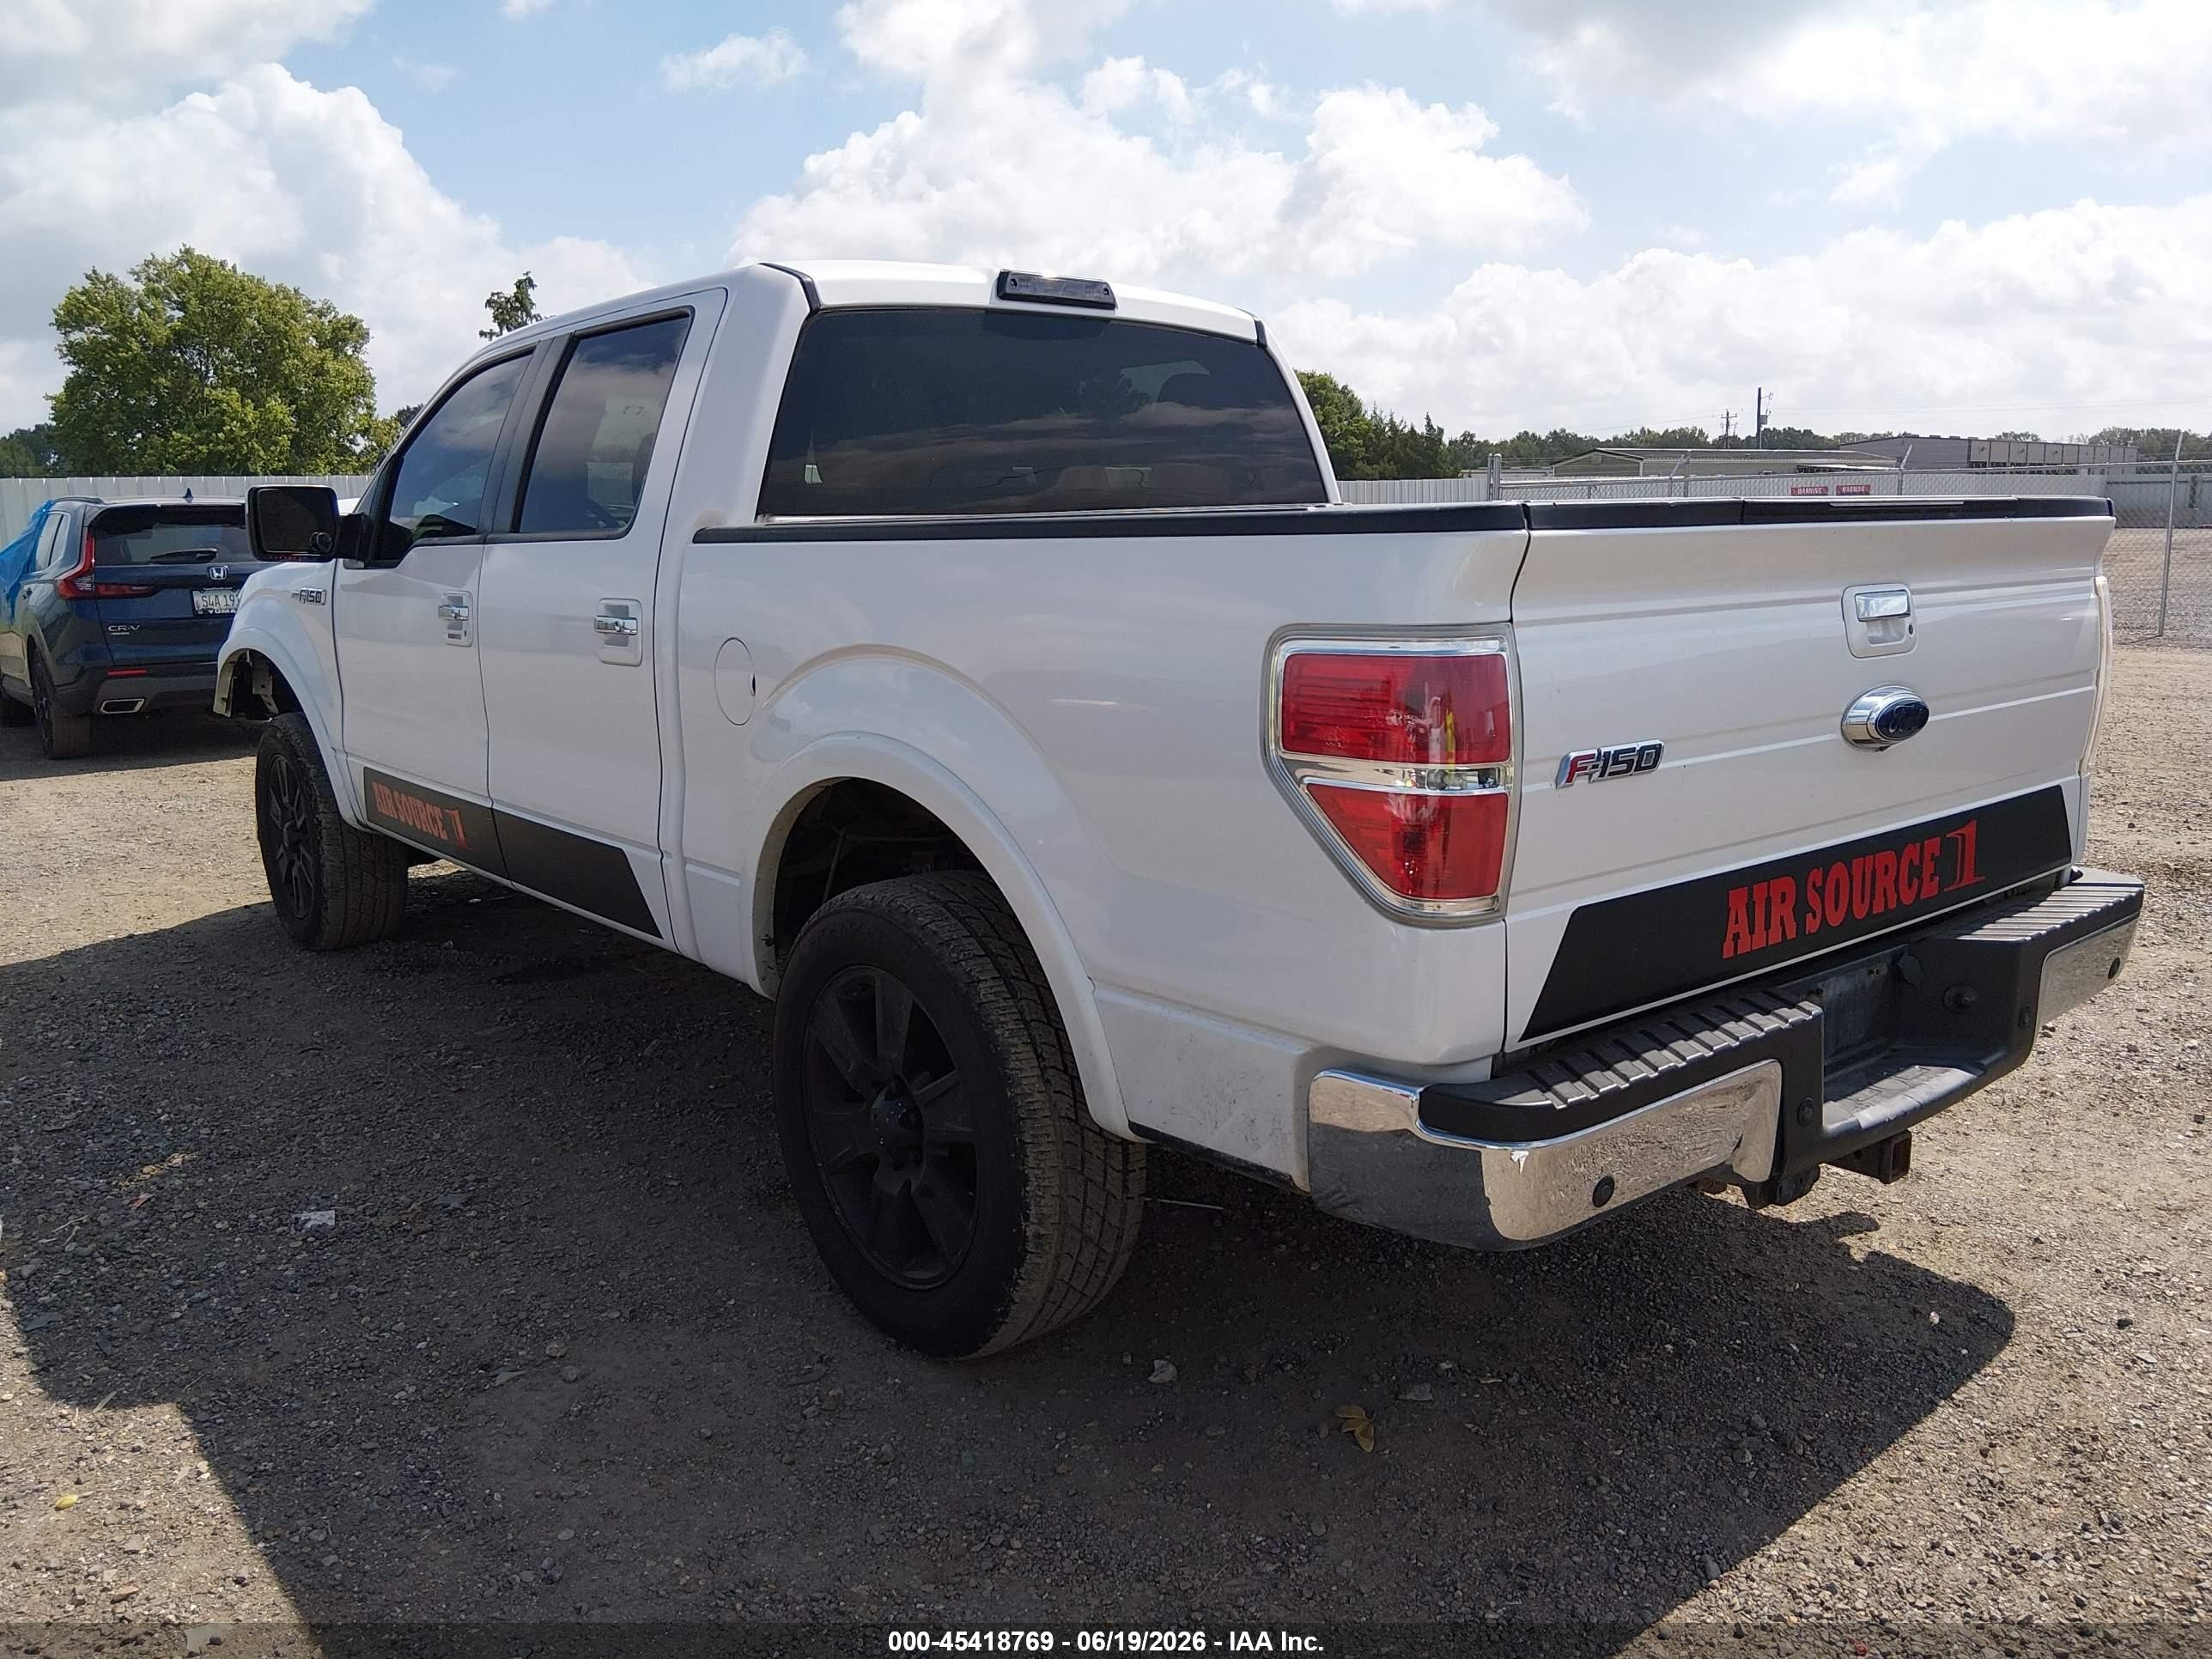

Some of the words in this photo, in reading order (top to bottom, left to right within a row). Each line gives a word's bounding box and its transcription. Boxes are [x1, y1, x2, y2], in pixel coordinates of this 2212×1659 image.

[202, 595, 221, 607] S4A
[1557, 739, 1664, 787] F-150
[372, 781, 398, 819] AIR
[394, 790, 448, 840] SOURCE
[1723, 876, 1797, 959] AIR
[1806, 836, 1941, 935] SOURCE
[1943, 819, 1986, 892] 1
